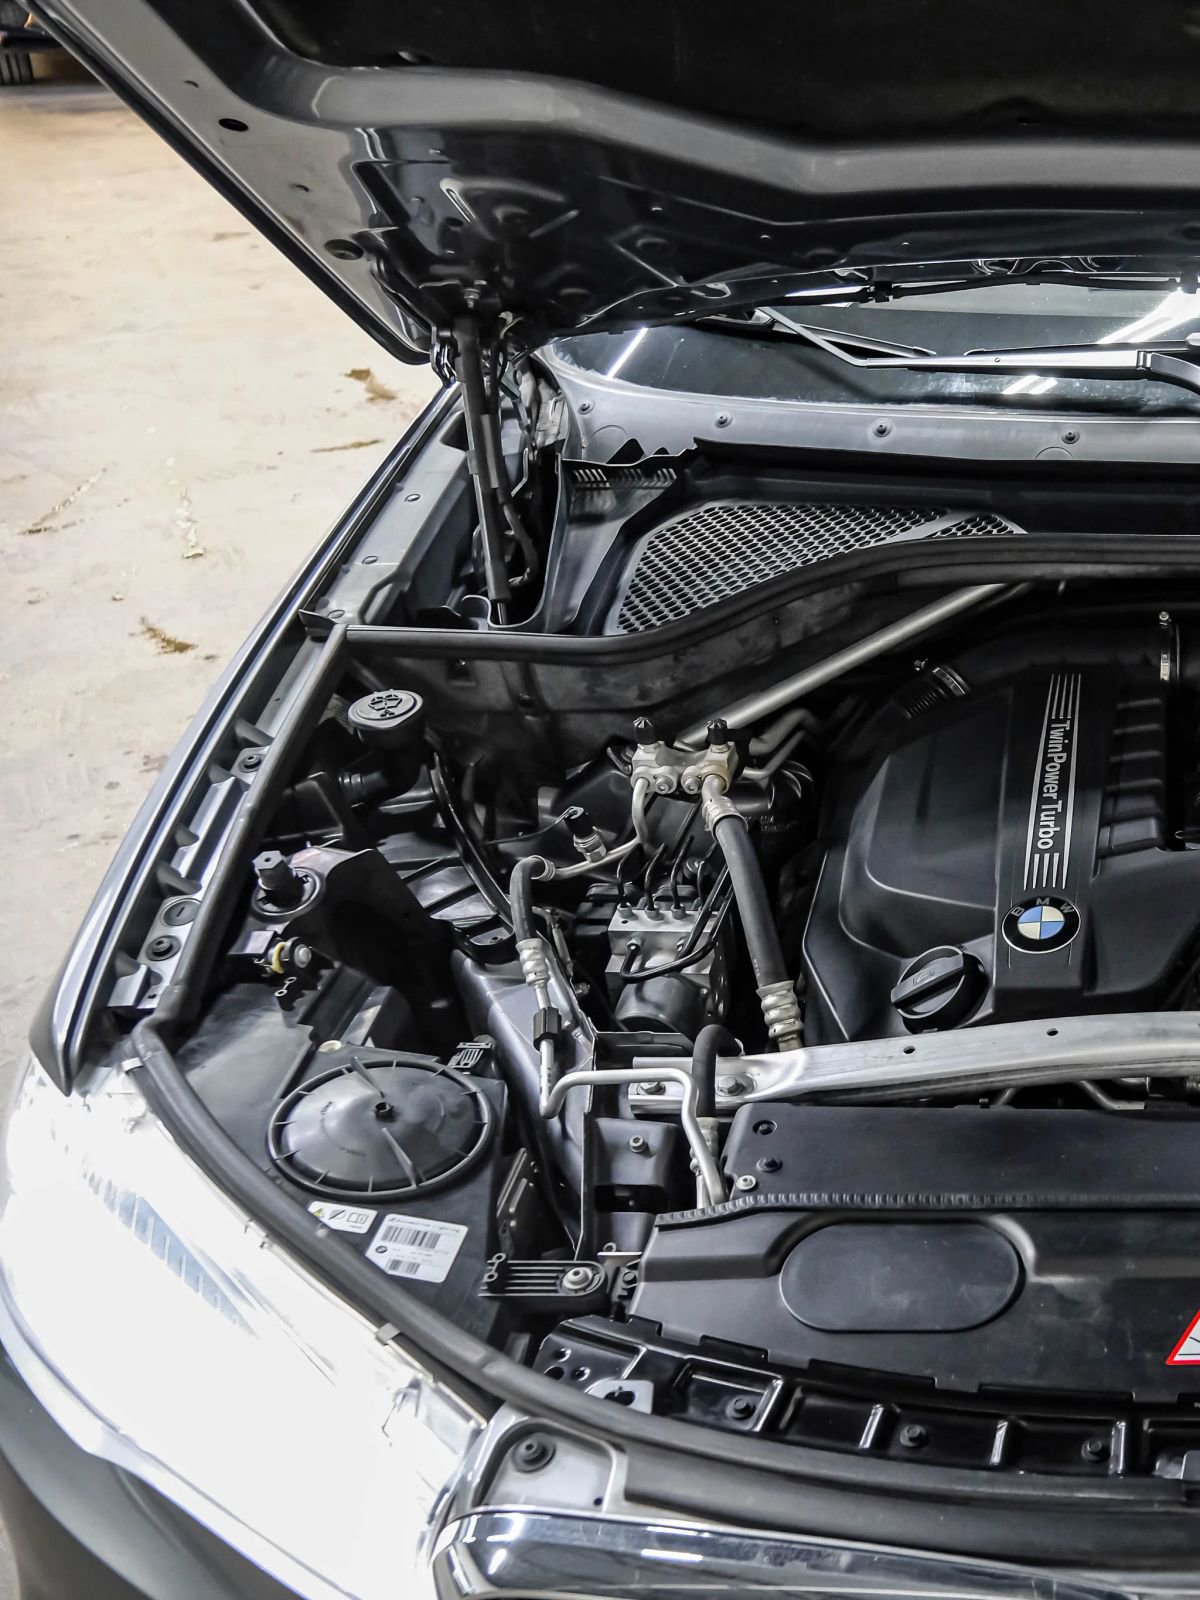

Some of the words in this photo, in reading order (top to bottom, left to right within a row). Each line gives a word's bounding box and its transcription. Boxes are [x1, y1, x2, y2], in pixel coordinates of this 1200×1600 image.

[1042, 719, 1070, 801] TwinPower
[1037, 800, 1063, 850] Turbo
[1011, 896, 1074, 917] BMW
